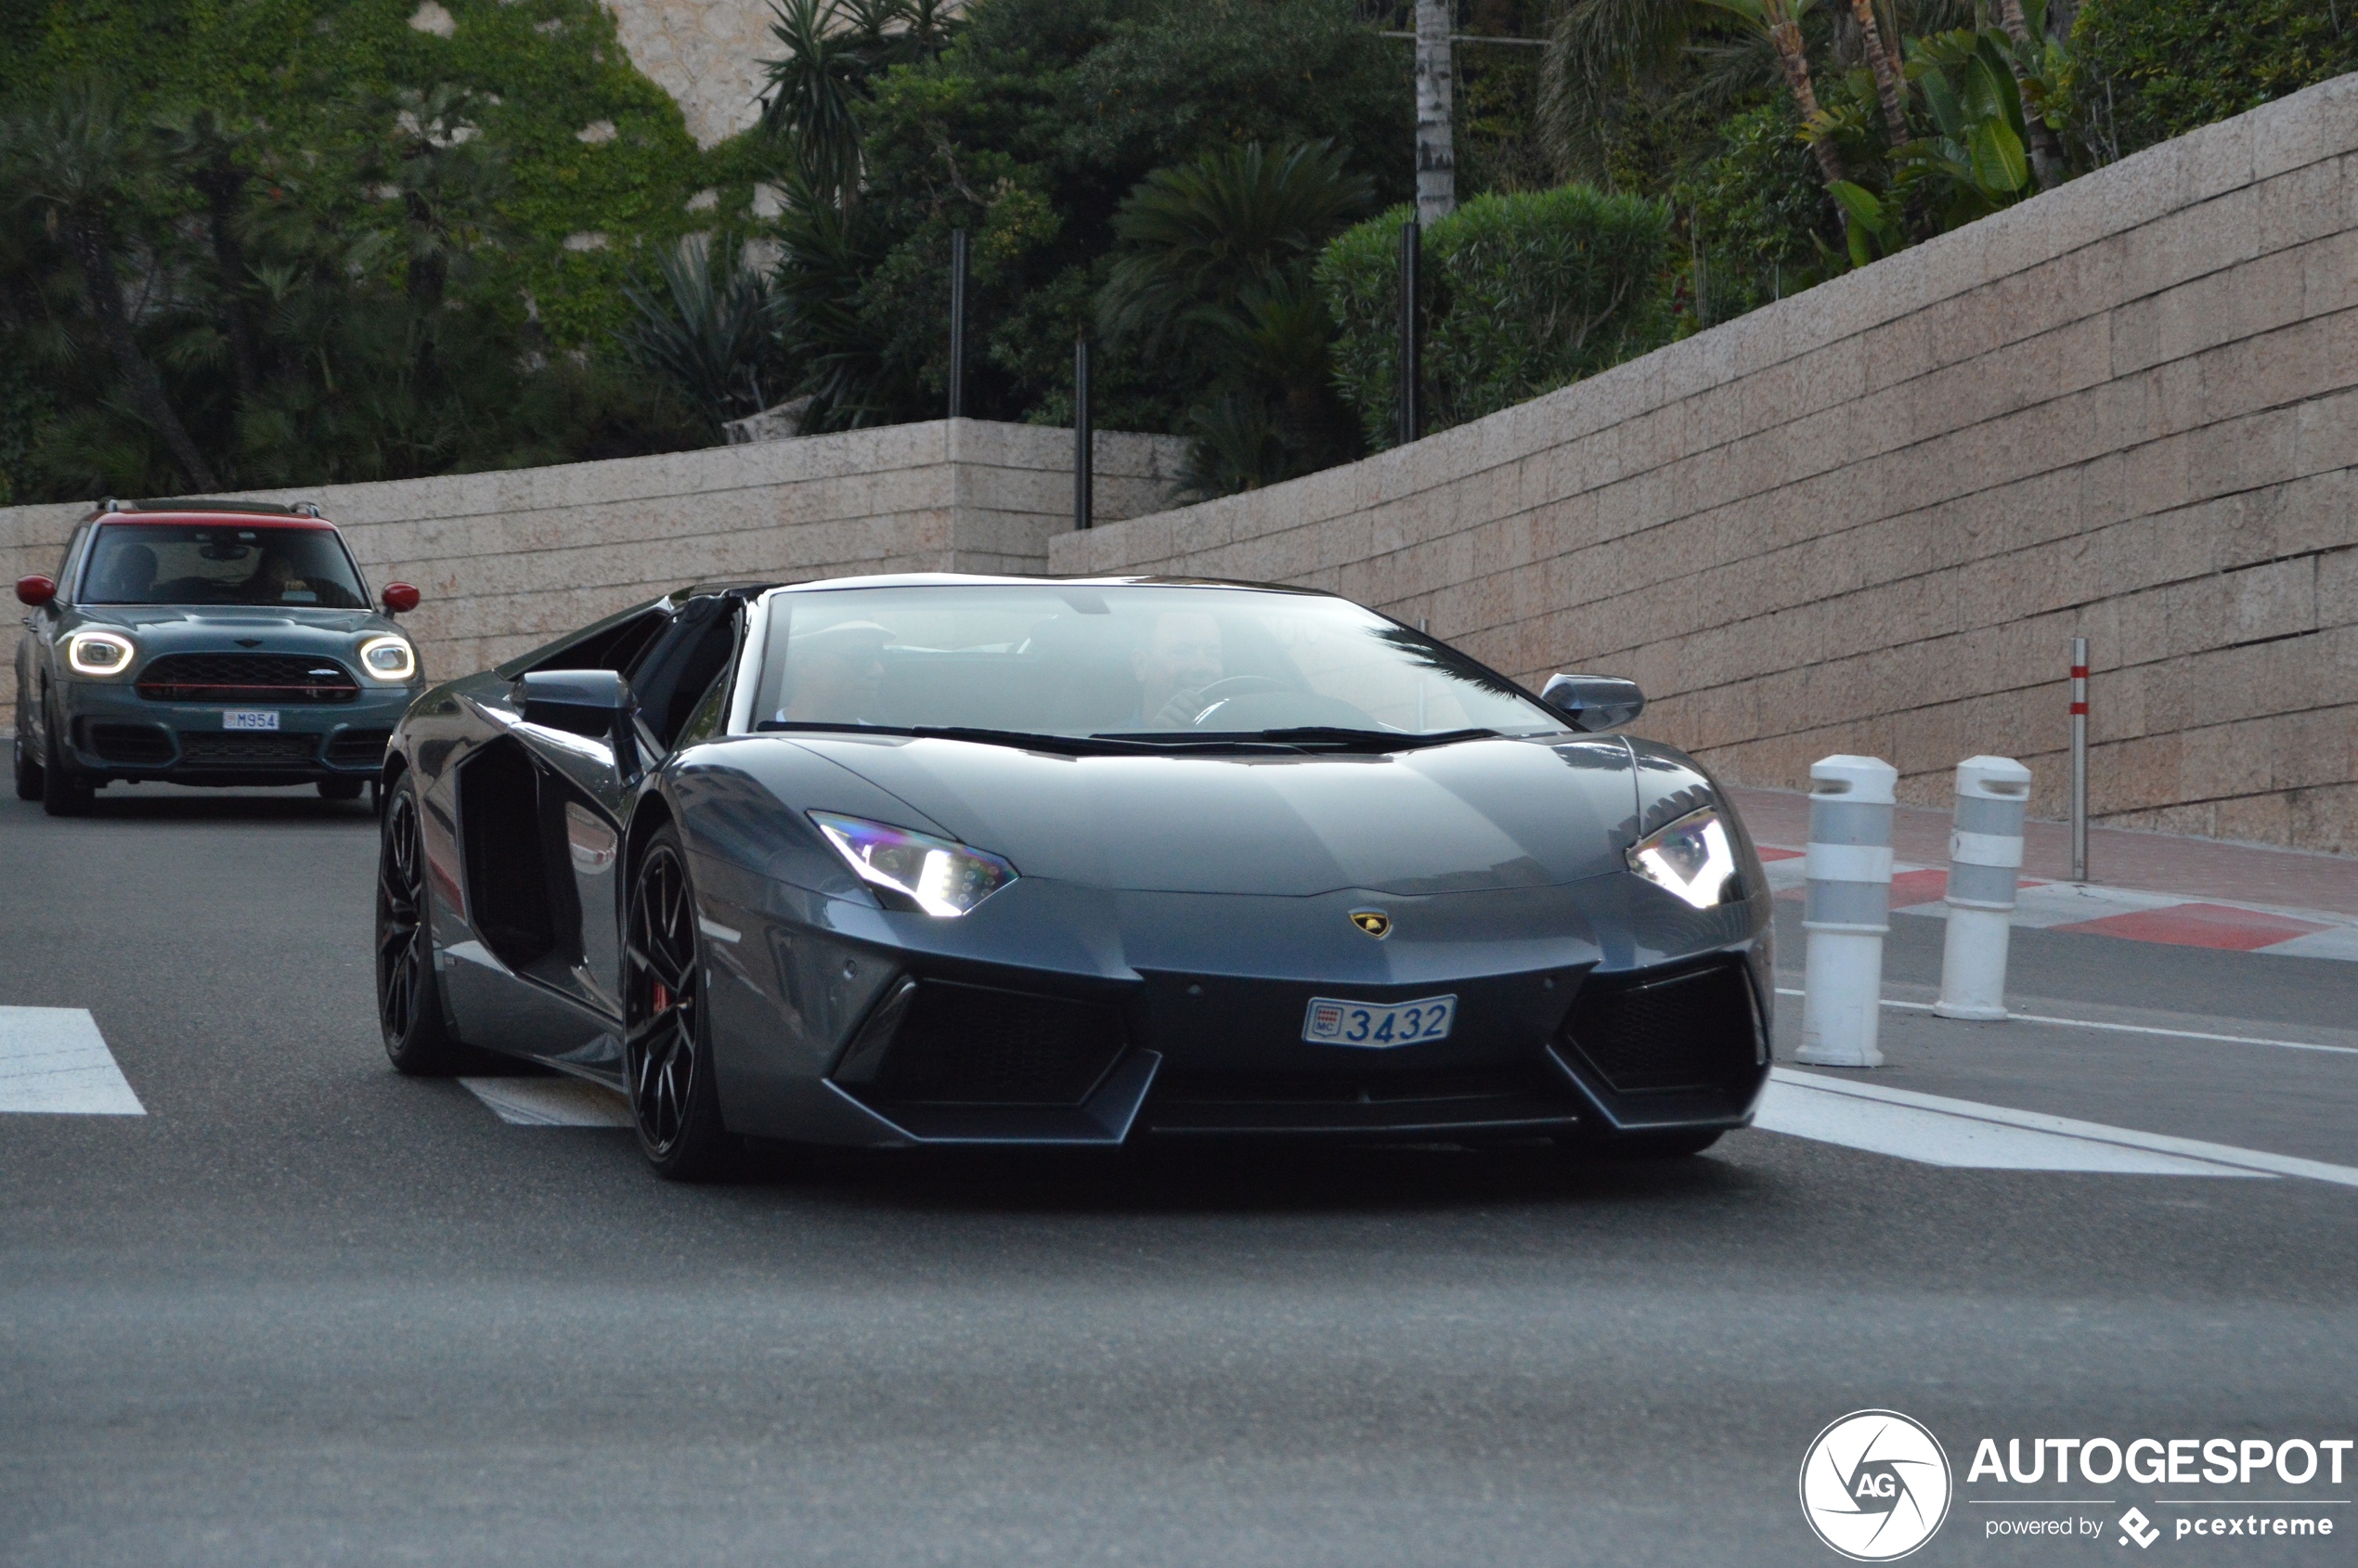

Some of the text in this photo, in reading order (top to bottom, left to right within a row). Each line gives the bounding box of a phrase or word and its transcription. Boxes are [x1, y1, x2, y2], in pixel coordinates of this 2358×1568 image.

[237, 713, 276, 728] M954
[1315, 1004, 1448, 1043] MC 3432
